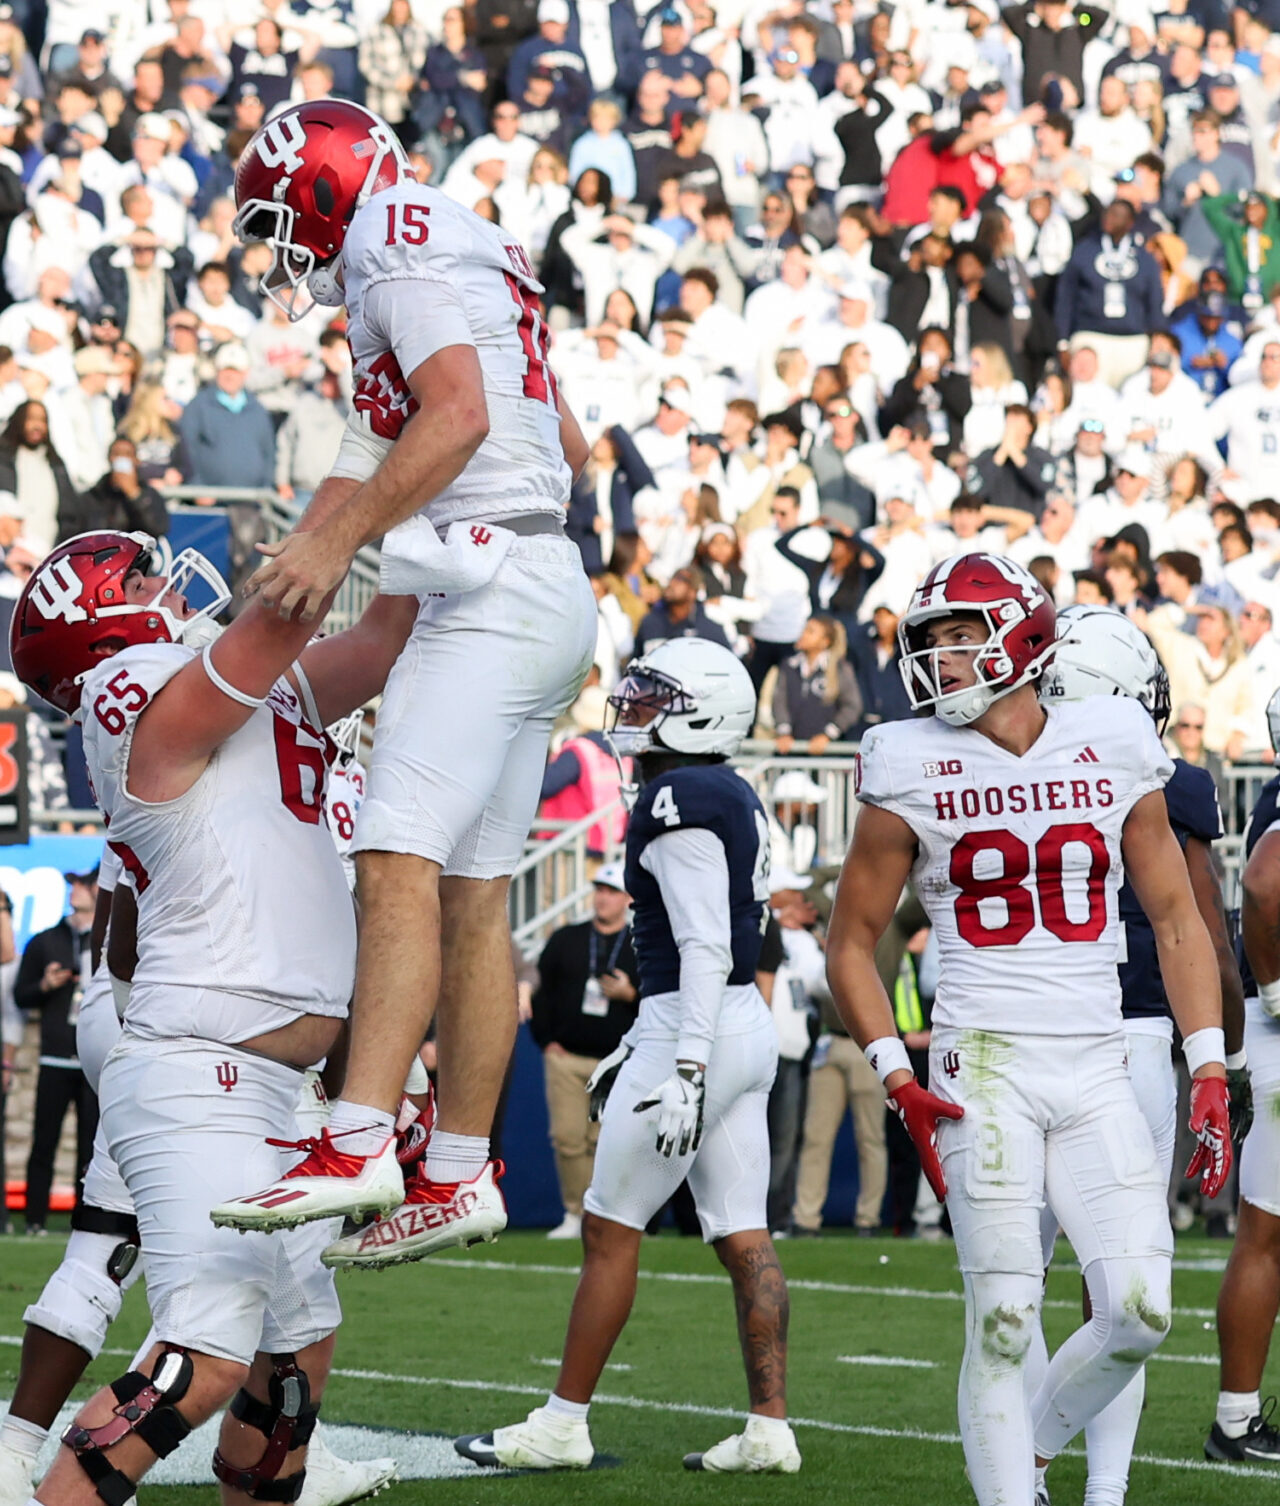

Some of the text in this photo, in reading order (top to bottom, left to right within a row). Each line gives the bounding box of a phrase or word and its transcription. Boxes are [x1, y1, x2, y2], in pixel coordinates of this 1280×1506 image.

[385, 204, 431, 246] 15
[93, 669, 149, 736] 65
[923, 759, 963, 778] B1G
[651, 786, 681, 827] 4
[933, 779, 1114, 821] HOOSIERS
[949, 822, 1110, 948] 80
[358, 1191, 478, 1253] ADIZERO
